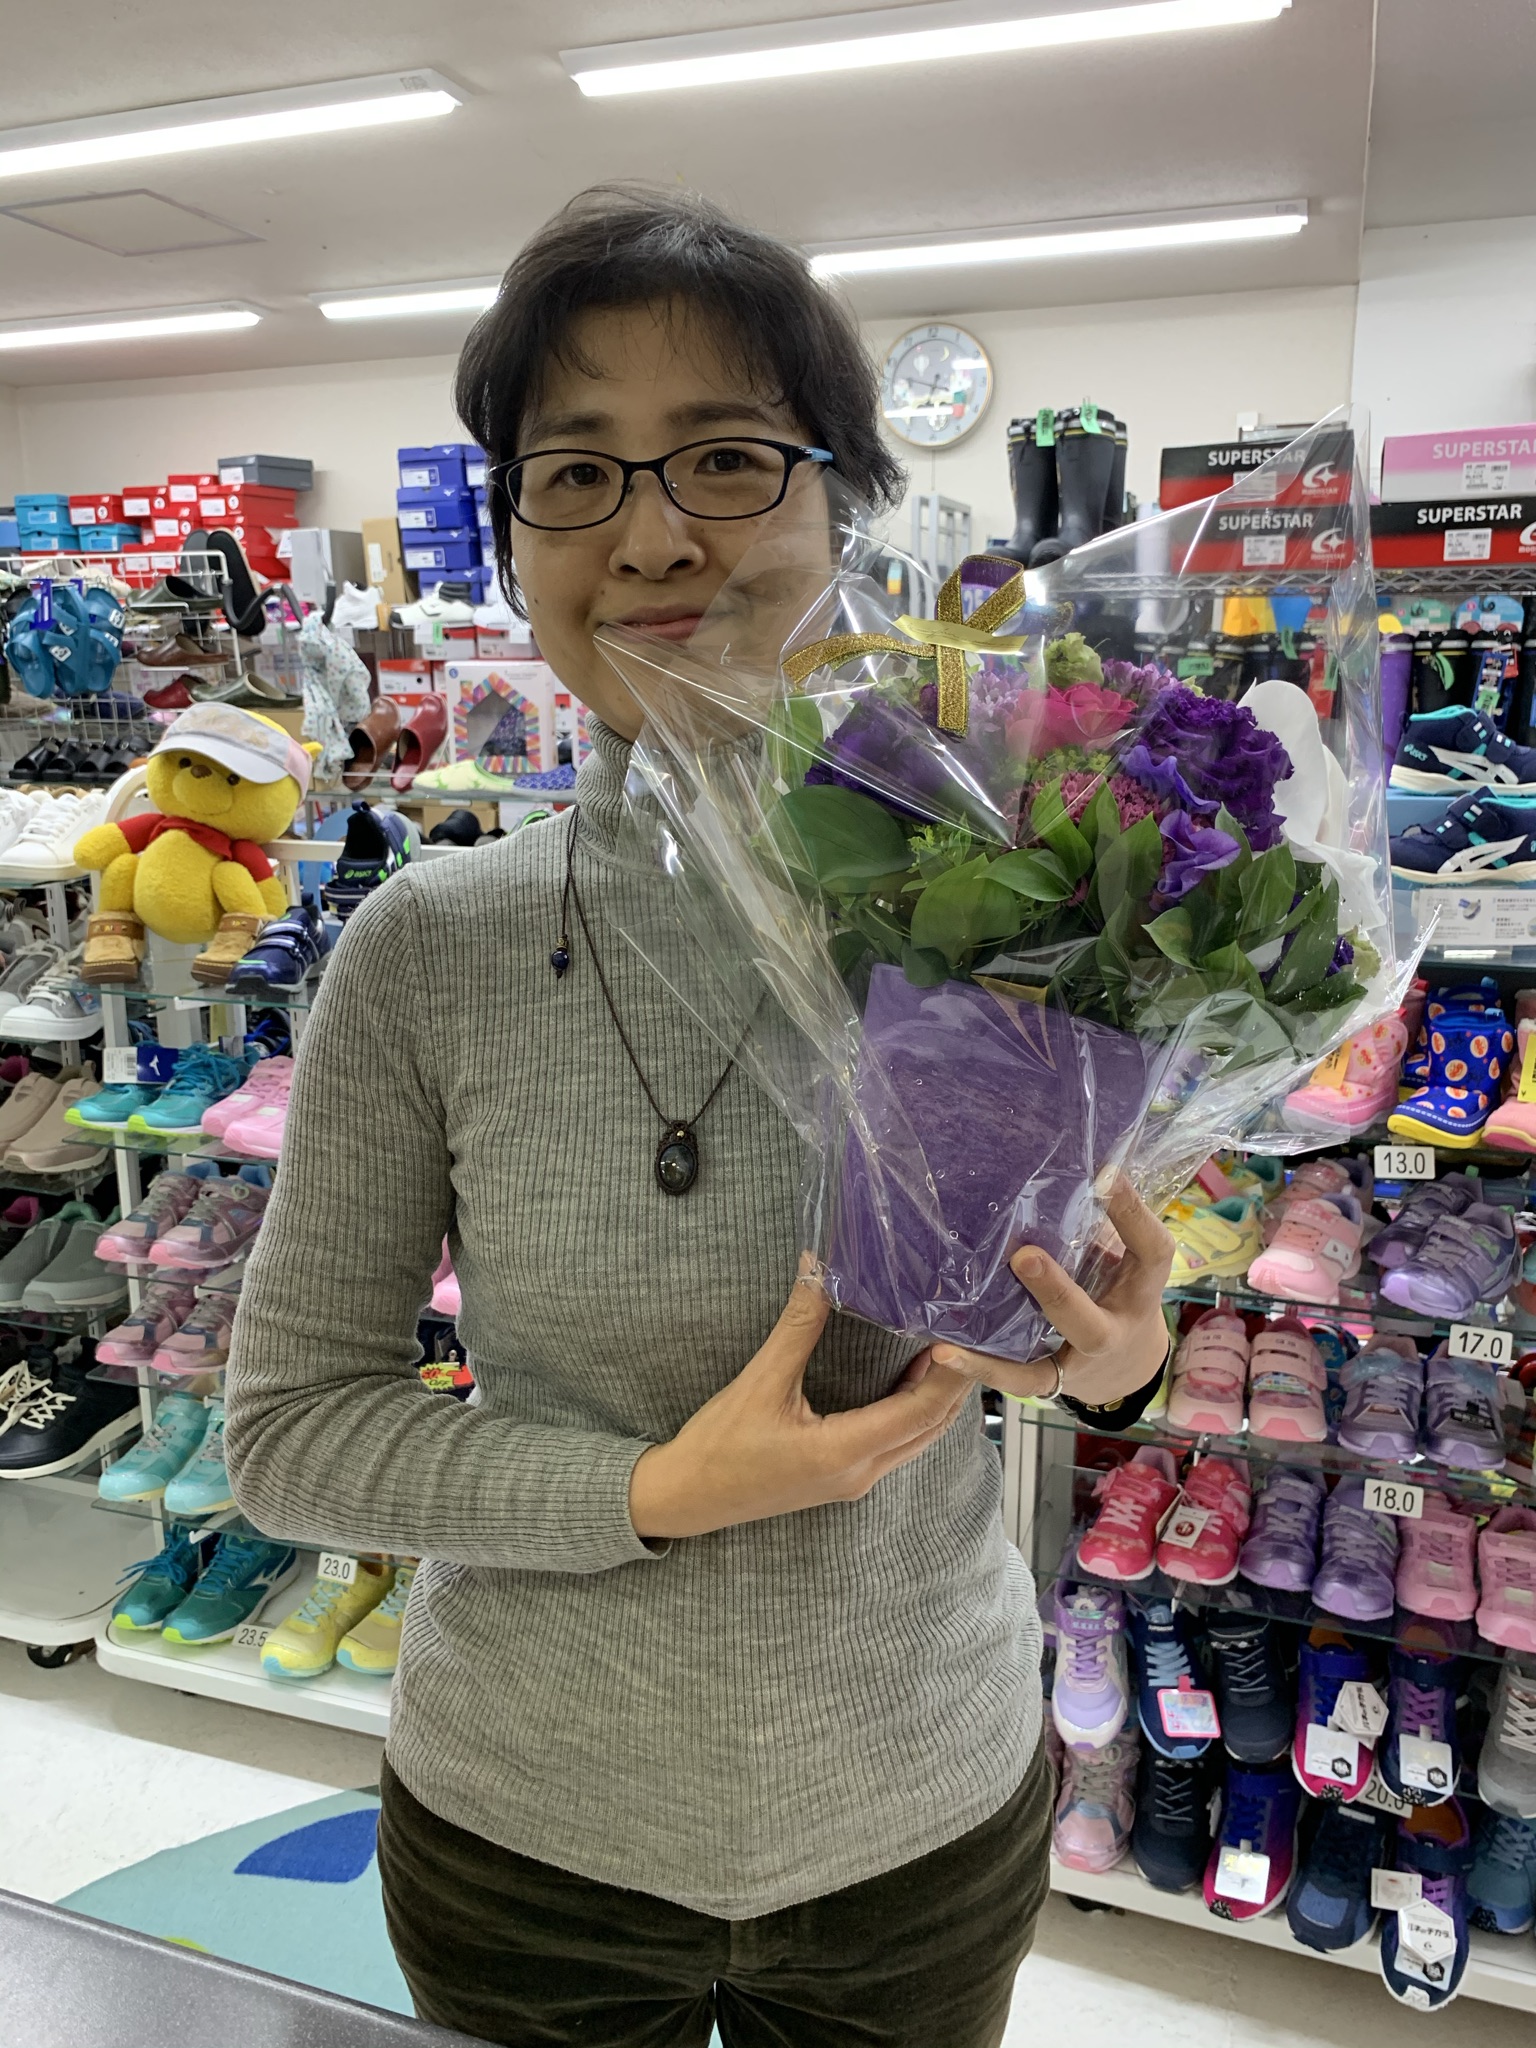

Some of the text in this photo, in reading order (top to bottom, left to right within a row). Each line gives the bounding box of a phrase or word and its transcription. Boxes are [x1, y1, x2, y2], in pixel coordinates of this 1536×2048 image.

[1207, 448, 1306, 467] SUPERSTAR
[1432, 438, 1536, 460] SUPERSTA
[1218, 512, 1314, 531] SUPERSTAR
[1416, 503, 1523, 525] SUPERSTAR
[1383, 1151, 1426, 1174] 13.0
[1458, 1331, 1503, 1359] 17.0
[1372, 1486, 1415, 1512] 18.0
[323, 1557, 351, 1580] 23.0
[238, 1627, 269, 1647] 23.5
